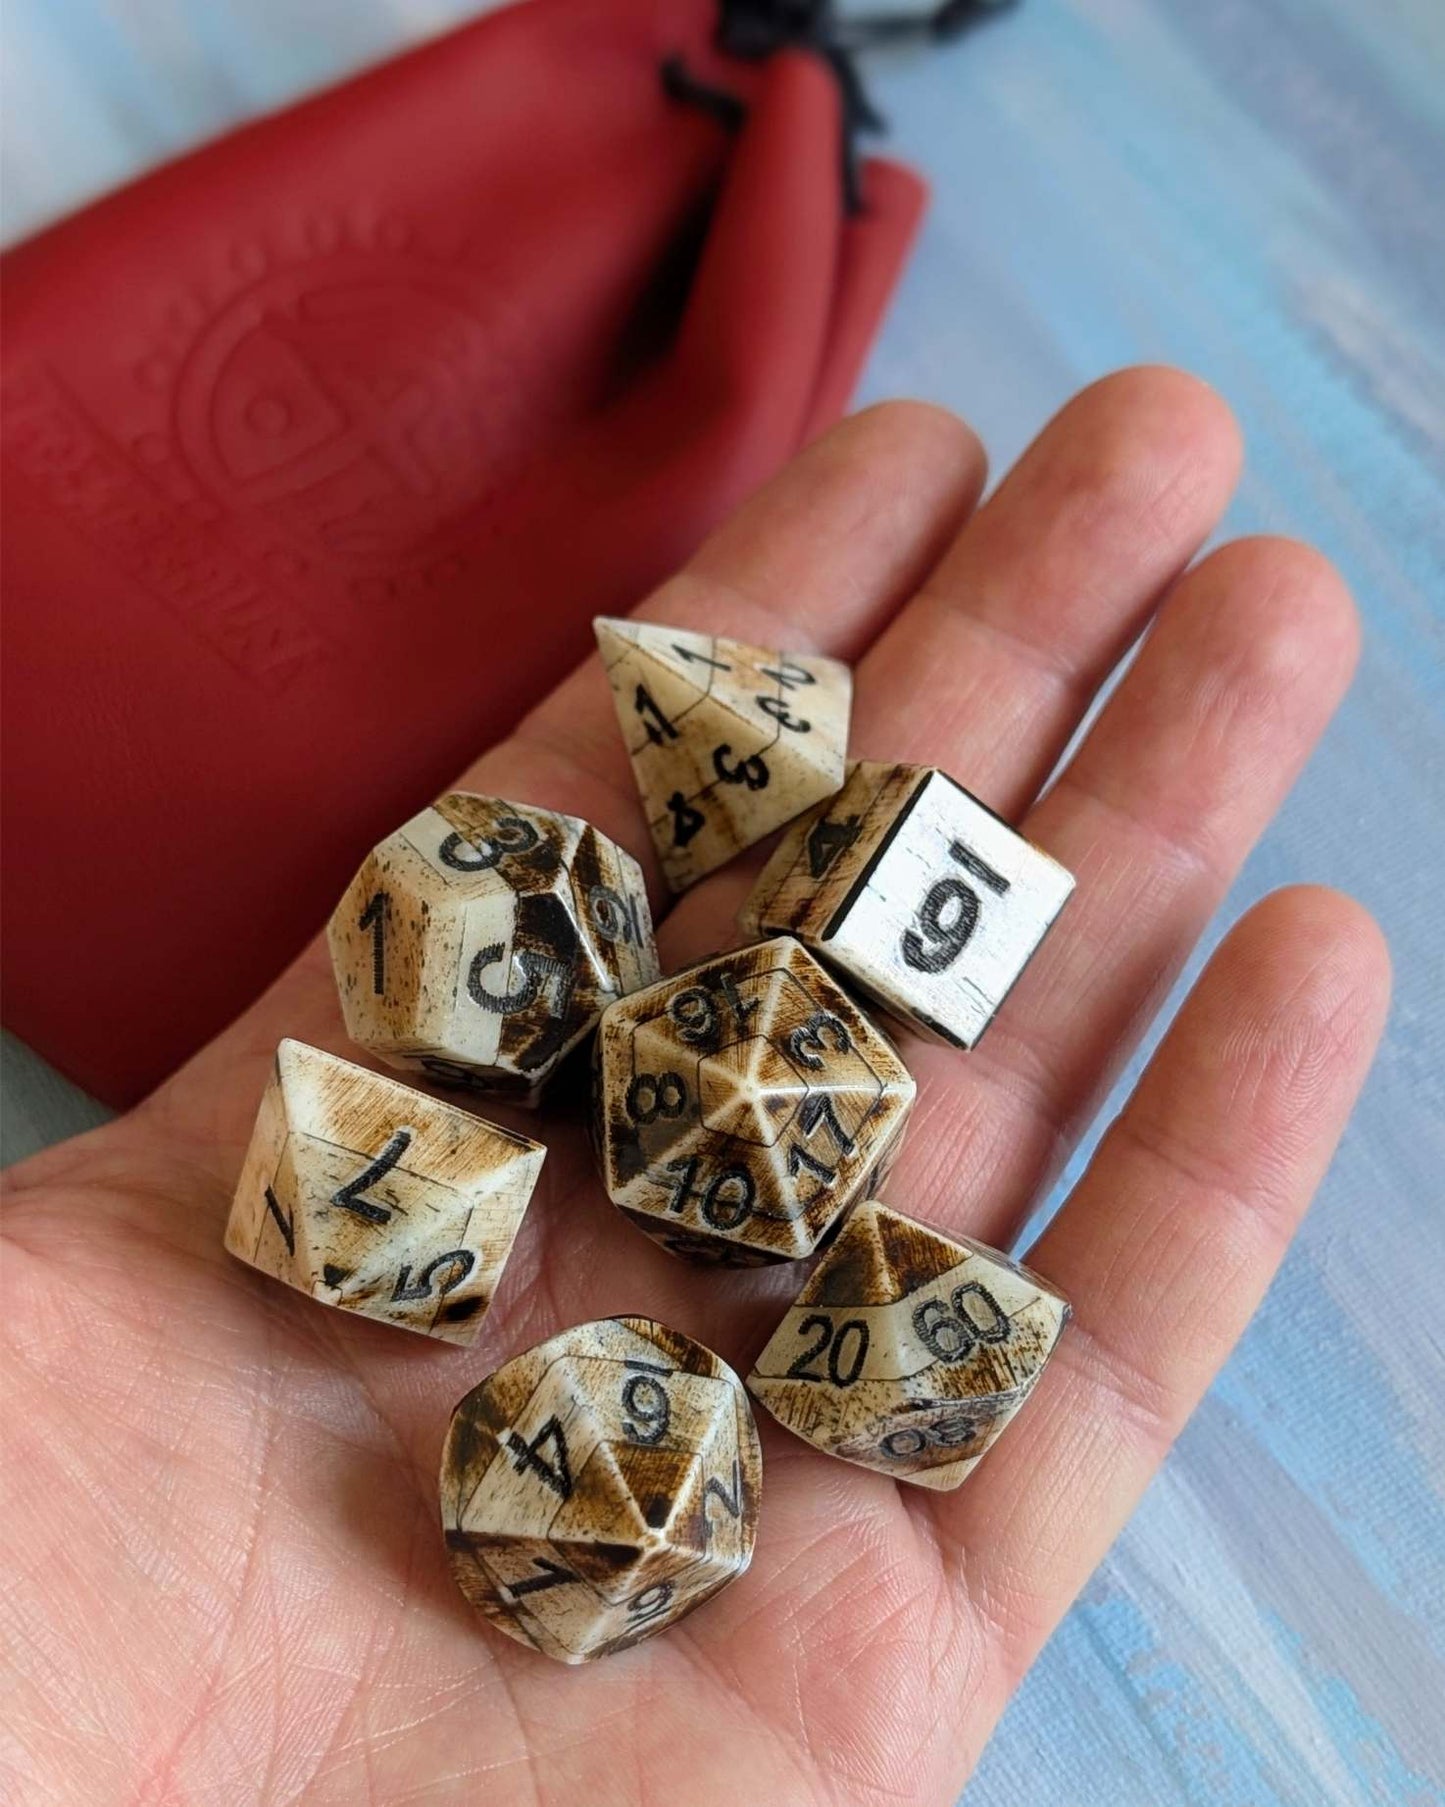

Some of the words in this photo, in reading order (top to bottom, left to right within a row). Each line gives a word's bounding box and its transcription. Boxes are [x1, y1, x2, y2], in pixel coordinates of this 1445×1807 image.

[670, 643, 733, 673] 1
[755, 695, 812, 734] 3
[712, 744, 770, 793] 3
[438, 816, 540, 874] 3
[666, 791, 706, 848] 4
[806, 815, 861, 878] 4
[358, 892, 389, 996] 1
[466, 942, 572, 1020] 5
[790, 1012, 852, 1072] 3
[624, 1072, 687, 1126] 8
[788, 1094, 858, 1184] 17
[331, 1129, 412, 1225] 7
[664, 1157, 756, 1230] 10
[391, 1250, 475, 1301] 5
[786, 1314, 871, 1388] 20
[911, 1280, 1011, 1364] 60
[505, 1415, 573, 1502] 4
[505, 1556, 582, 1599] 1
